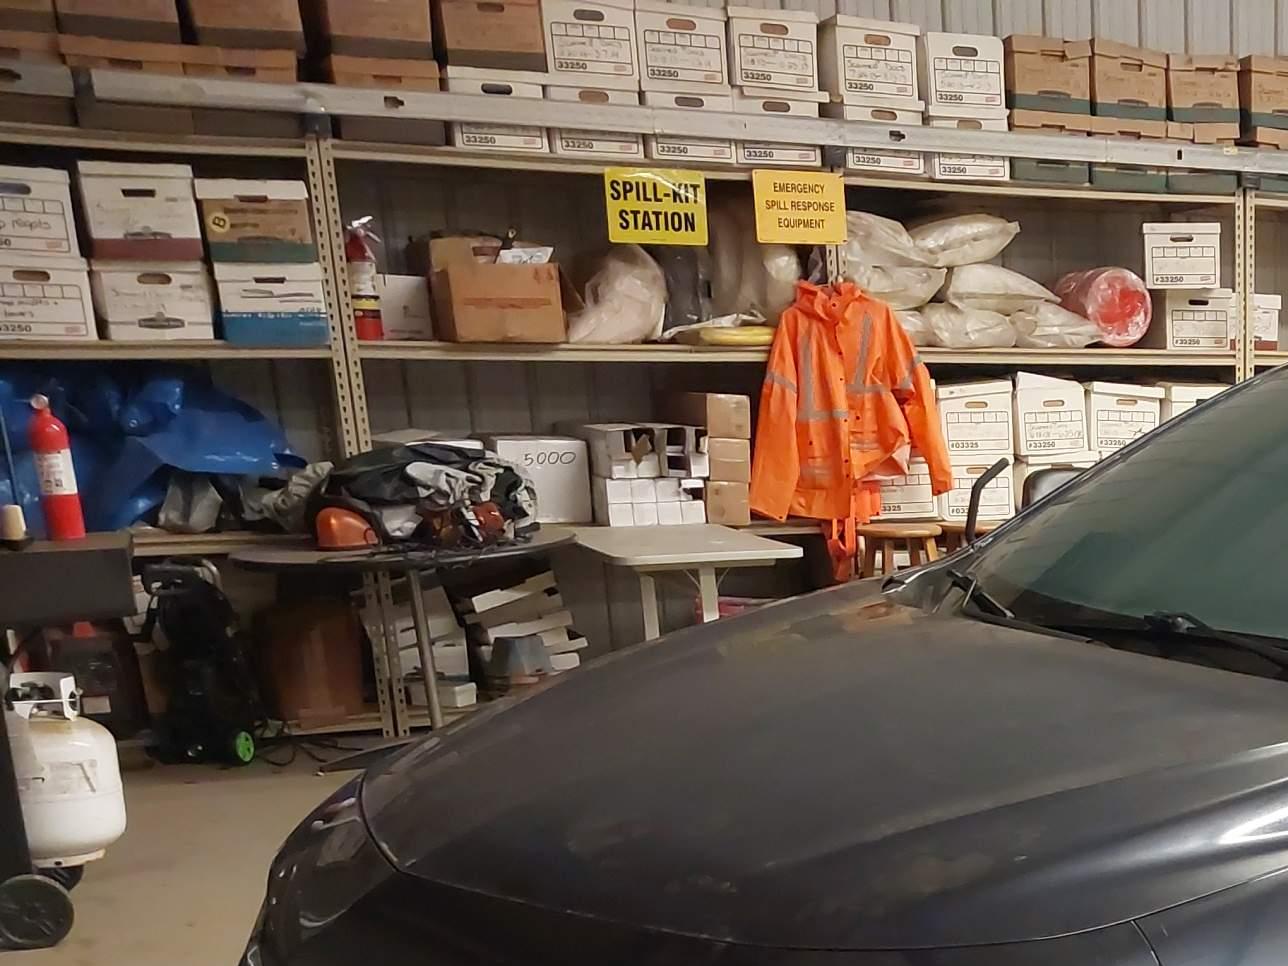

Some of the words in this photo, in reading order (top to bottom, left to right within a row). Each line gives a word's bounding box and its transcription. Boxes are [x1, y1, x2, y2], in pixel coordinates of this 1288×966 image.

[557, 60, 588, 70] 33250
[649, 68, 679, 78] 33250
[743, 71, 772, 81] 33250
[847, 82, 874, 91] 33250
[938, 93, 964, 102] 33250
[465, 135, 496, 145] 33250
[563, 140, 594, 149] 33250
[659, 145, 688, 154] 33250
[746, 150, 774, 158] 33250
[855, 156, 881, 164] 33250
[941, 166, 967, 174] 33250
[610, 179, 701, 204] SPILL-KIT
[773, 182, 825, 195] EMERGENCY
[765, 200, 789, 211] SPILL
[790, 201, 835, 213] RESPONSE
[212, 216, 226, 229] B
[618, 209, 696, 232] STATION
[777, 217, 825, 230] EQUIPMENT
[0, 324, 32, 332] 3250
[523, 451, 577, 467] 5000
